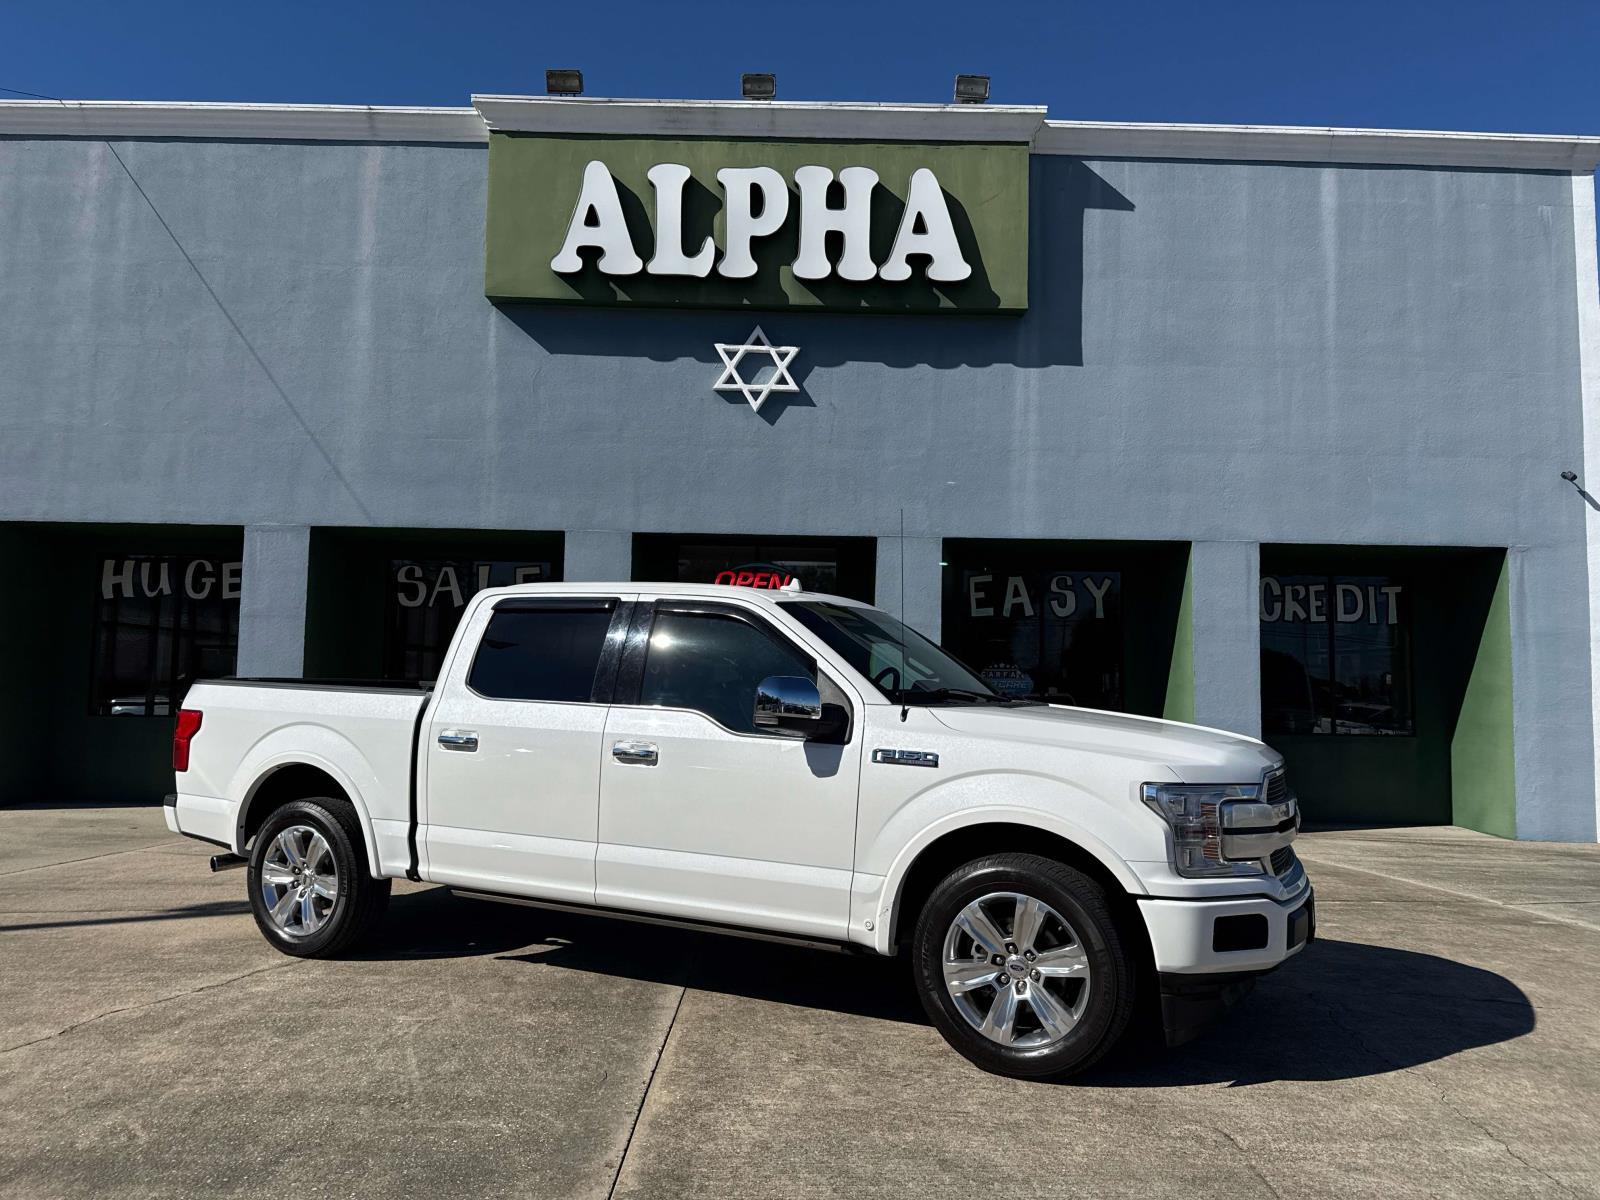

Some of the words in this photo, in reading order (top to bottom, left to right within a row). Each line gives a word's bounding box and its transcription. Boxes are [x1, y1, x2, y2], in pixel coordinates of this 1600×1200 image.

[550, 160, 972, 282] ALPHA
[101, 559, 242, 600] HUGE
[715, 570, 791, 589] OPEN
[969, 575, 1113, 619] EASY
[1260, 576, 1403, 625] CREDIT
